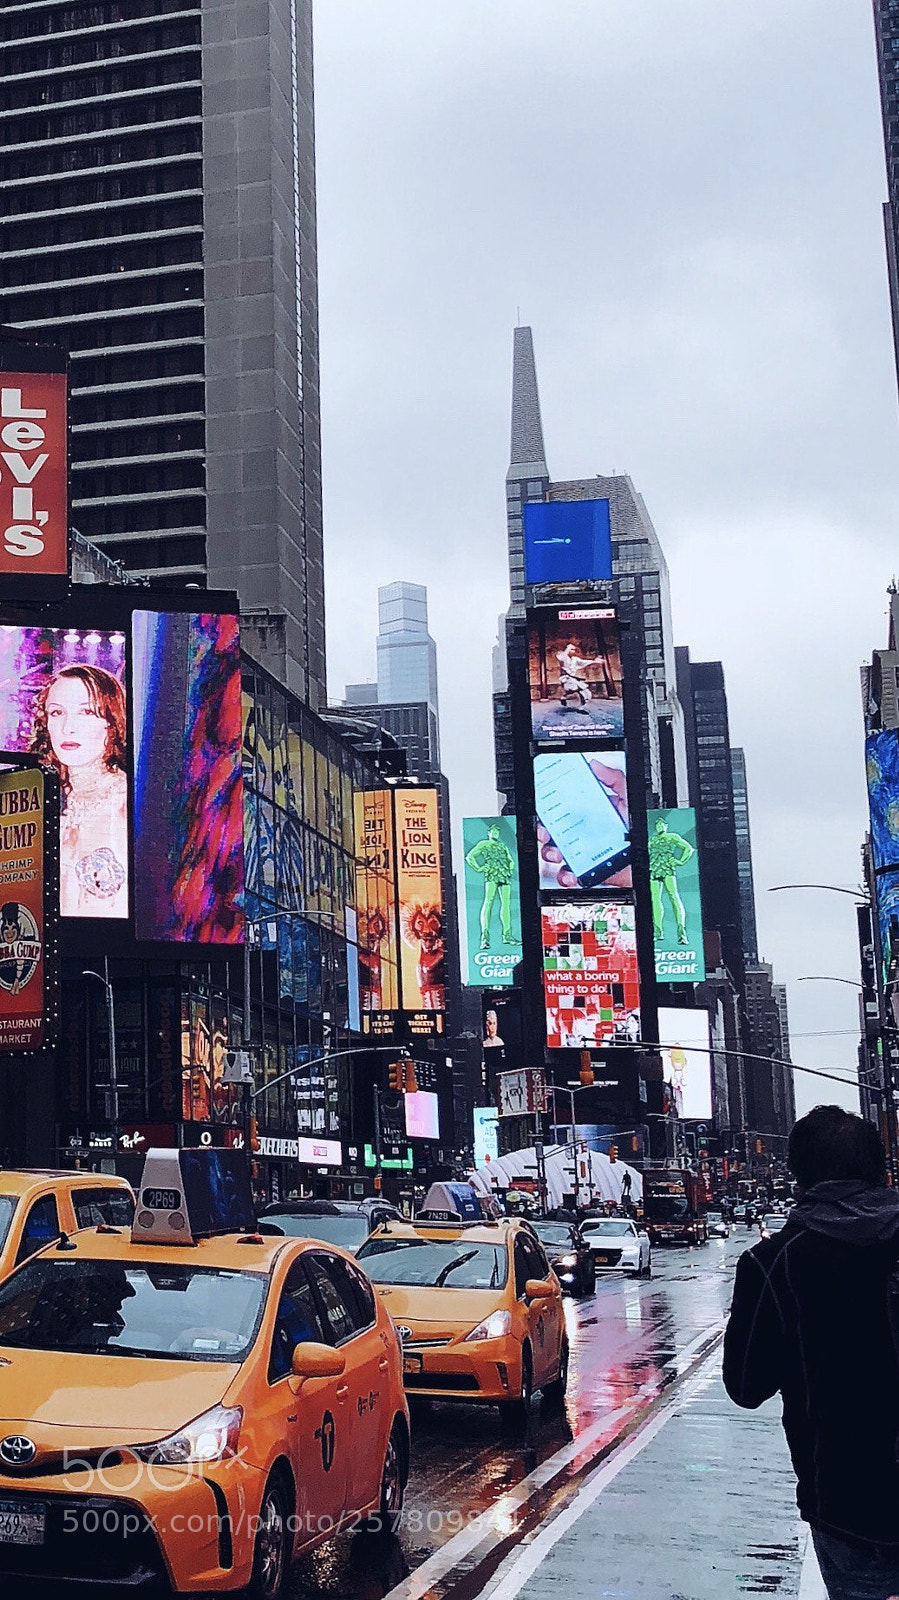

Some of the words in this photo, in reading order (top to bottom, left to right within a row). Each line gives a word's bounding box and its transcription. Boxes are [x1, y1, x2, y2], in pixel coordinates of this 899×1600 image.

[405, 817, 427, 828] THE
[402, 830, 432, 847] LION
[401, 848, 437, 869] KING
[17, 942, 40, 959] GUMP
[474, 952, 520, 966] Green
[655, 961, 698, 975] Giant
[547, 971, 573, 981] what
[584, 971, 619, 982] boring
[547, 984, 574, 995] thing
[577, 984, 588, 993] to
[148, 1191, 175, 1209] 2P69
